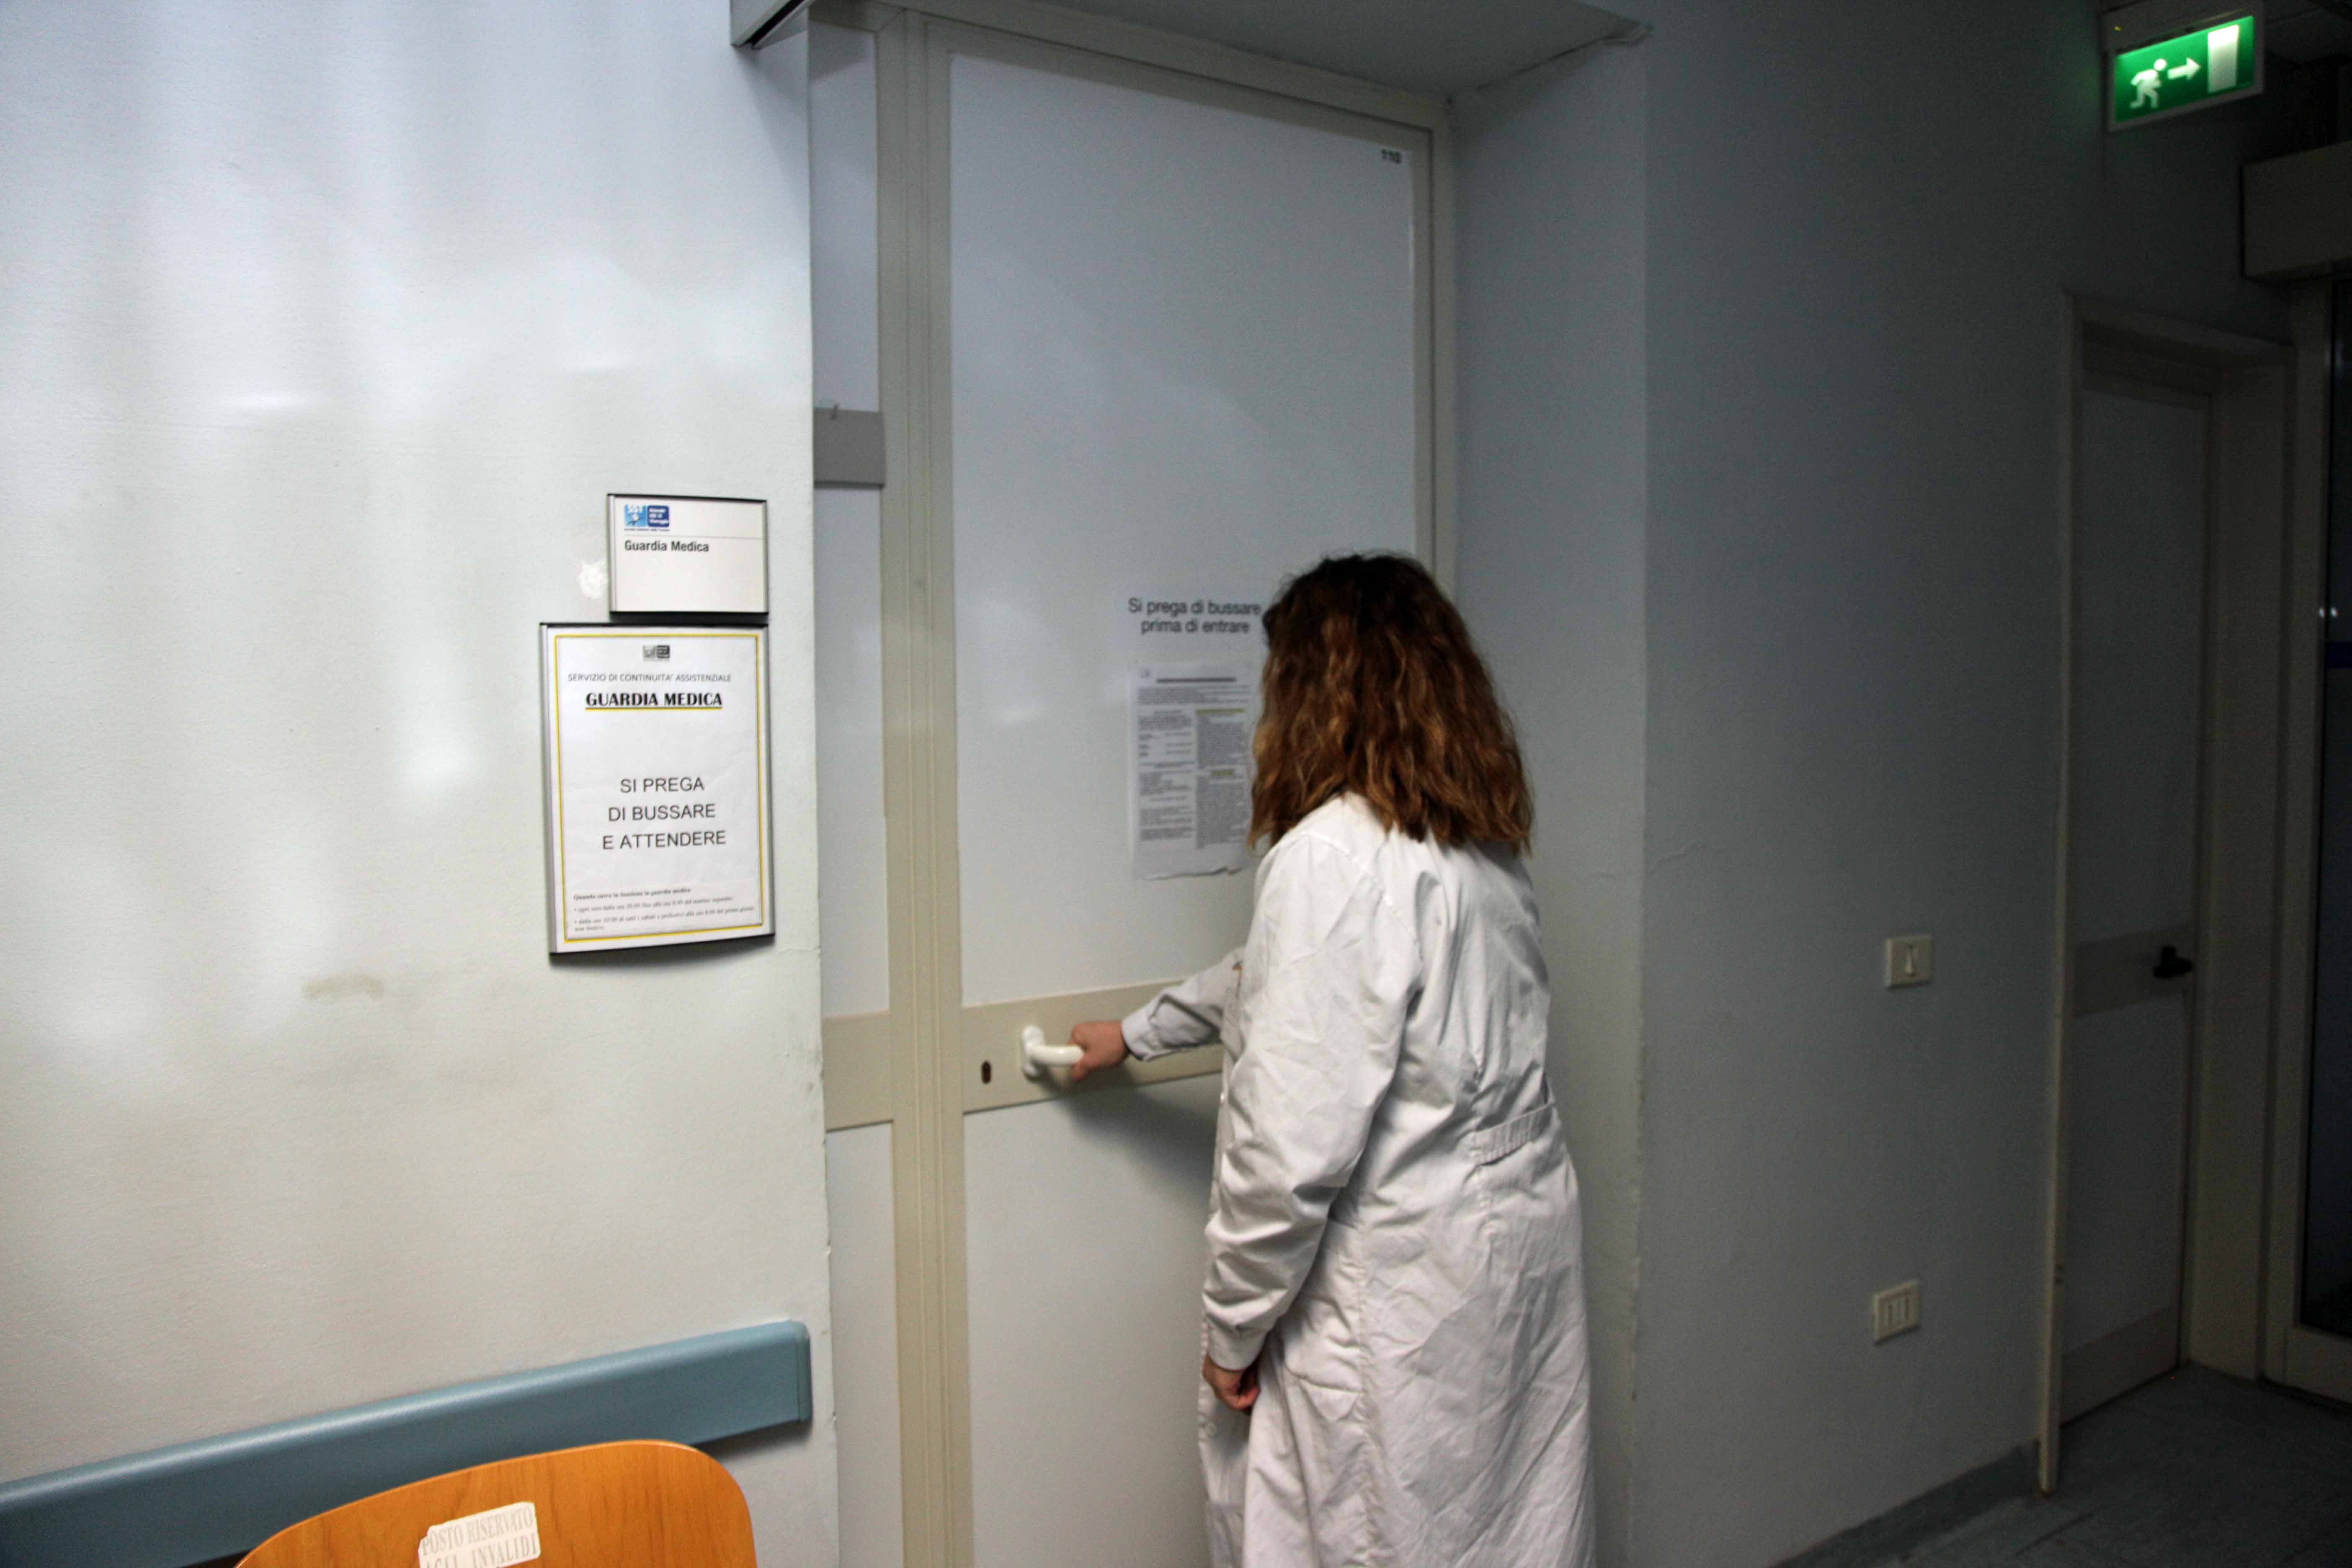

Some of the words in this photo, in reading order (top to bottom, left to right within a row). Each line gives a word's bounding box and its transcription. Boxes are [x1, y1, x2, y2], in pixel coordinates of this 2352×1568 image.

[624, 539, 667, 552] Guardia
[671, 540, 709, 552] Medica
[1128, 597, 1142, 613] Si
[1147, 601, 1187, 617] prega
[1191, 599, 1204, 614] di
[1208, 600, 1261, 615] bussare
[1141, 619, 1181, 635] prima
[1185, 618, 1198, 633] di
[1202, 619, 1250, 633] entrare
[567, 673, 606, 682] SERVIZIO
[609, 673, 617, 682] DI
[676, 673, 732, 682] ASSISTENZIALE
[585, 692, 658, 706] GUARDIA
[664, 692, 722, 706] MEDICA
[620, 778, 637, 793] SI
[643, 776, 705, 792] PREGA
[609, 807, 625, 822] DI
[632, 803, 716, 821] BUSSARE
[603, 835, 614, 850] E
[619, 830, 726, 848] ATTENDERE
[422, 1524, 463, 1557] POSTO
[465, 1507, 533, 1544] RISERVATO
[472, 1532, 538, 1568] INVALIDI
